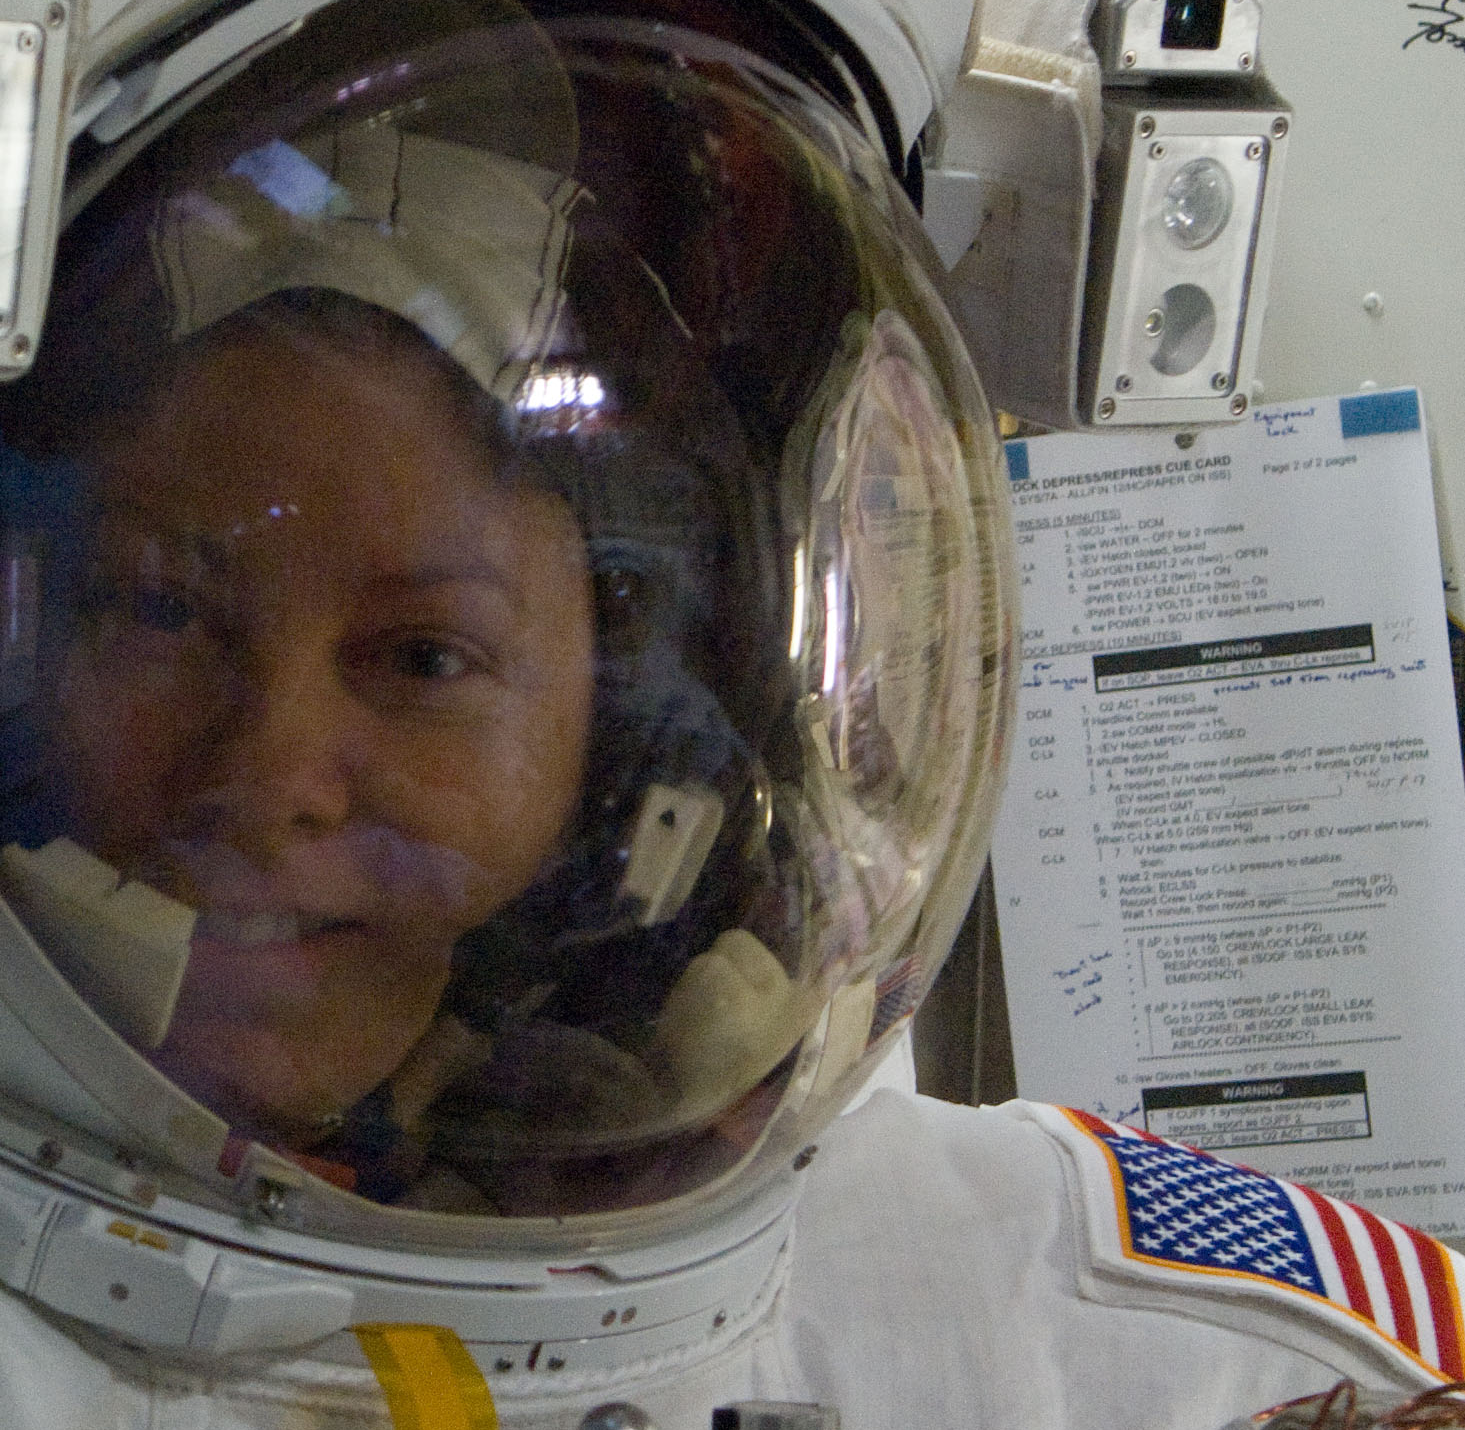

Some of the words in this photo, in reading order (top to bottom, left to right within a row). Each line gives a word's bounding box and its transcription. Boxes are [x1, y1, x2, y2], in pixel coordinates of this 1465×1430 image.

[1042, 465, 1162, 490] DEPRESS/REPRESS
[1165, 461, 1191, 473] CUE
[1195, 455, 1231, 469] CARD
[1263, 464, 1291, 477] Page
[1303, 459, 1313, 469] of
[1325, 455, 1357, 468] pages
[1099, 536, 1140, 549] WATER
[1235, 546, 1268, 560] OPEN
[1108, 617, 1151, 631] POWER
[1200, 641, 1263, 660] WARNING
[1222, 1082, 1285, 1100] WARNING
